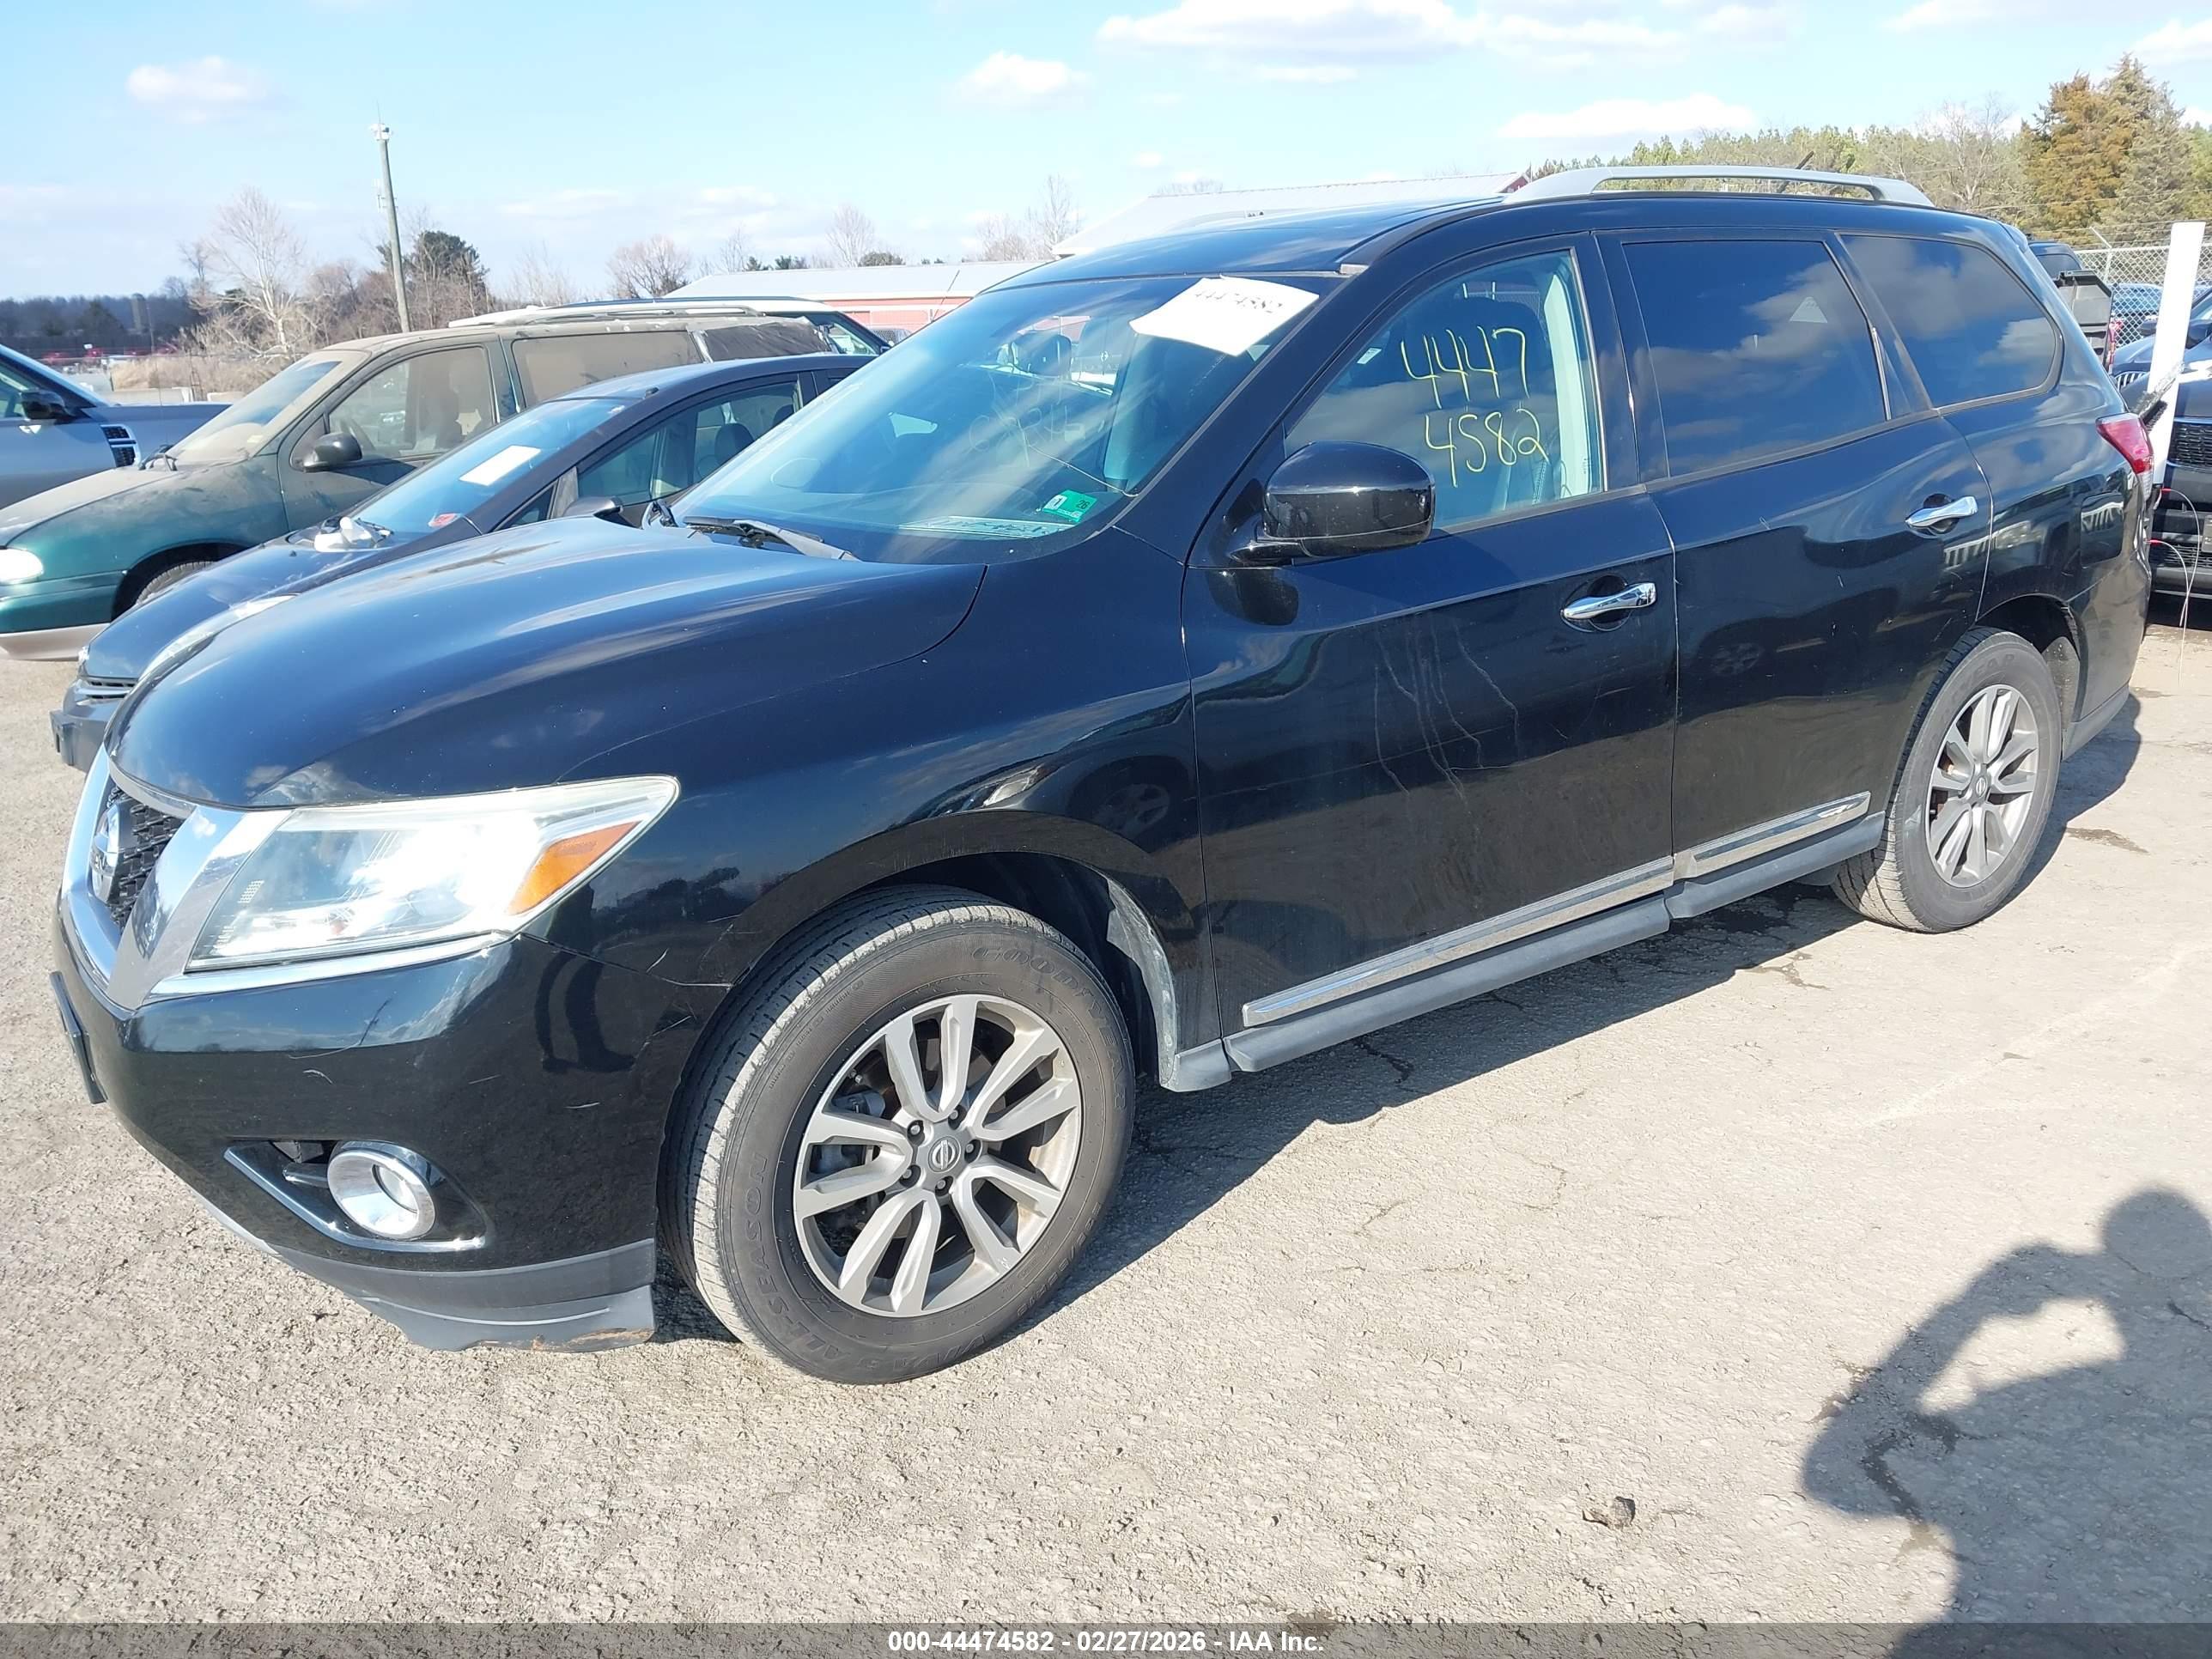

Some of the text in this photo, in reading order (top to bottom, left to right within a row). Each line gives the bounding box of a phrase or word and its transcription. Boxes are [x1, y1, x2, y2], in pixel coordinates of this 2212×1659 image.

[1401, 325, 1531, 410] 4447
[1425, 407, 1549, 488] 4582
[1078, 500, 1091, 510] 26
[971, 946, 1127, 1111] GOODYEAR
